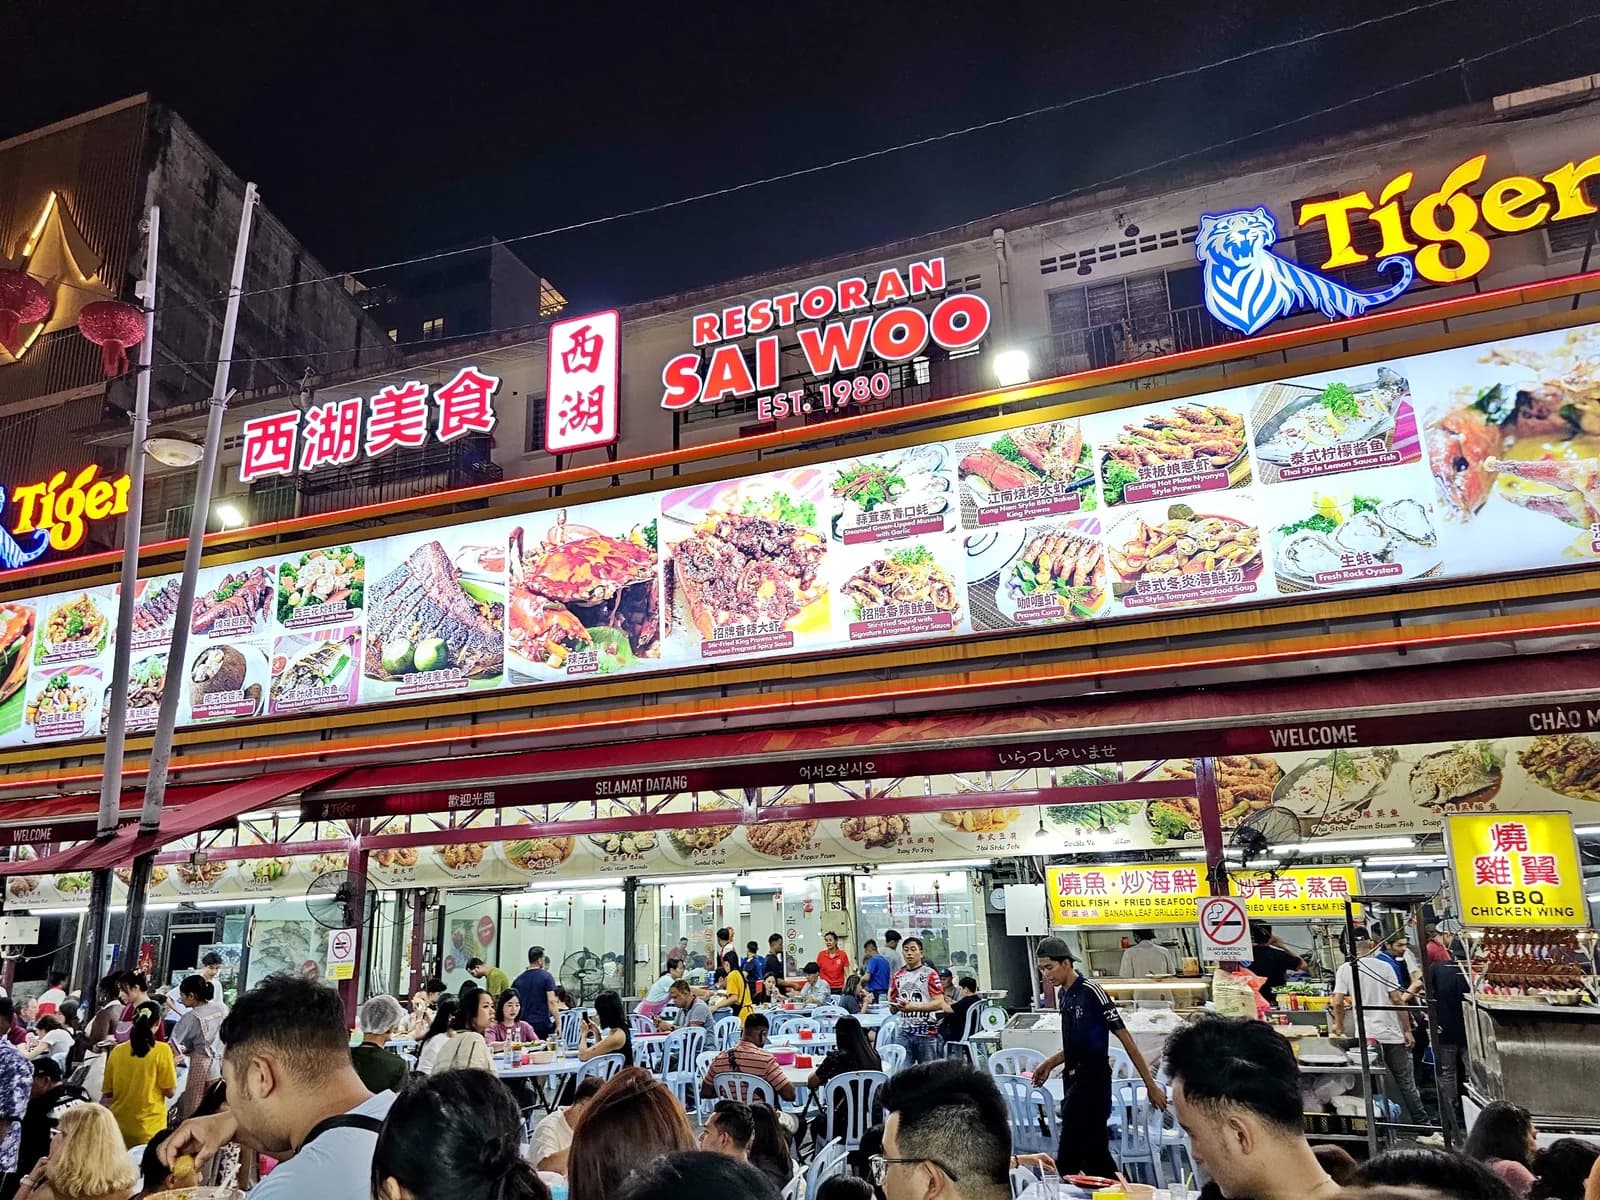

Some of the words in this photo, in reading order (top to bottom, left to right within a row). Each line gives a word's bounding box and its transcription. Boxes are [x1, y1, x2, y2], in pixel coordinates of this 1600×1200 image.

[1298, 154, 1600, 283] Tiger
[692, 257, 946, 346] RESTORAN
[661, 335, 780, 410] SAI
[798, 293, 991, 376] WOO
[559, 325, 605, 436] 西湖
[758, 391, 811, 420] EST.
[821, 372, 890, 407] 1980
[240, 367, 499, 482] 西湖美食
[1302, 466, 1322, 474] Style
[1324, 462, 1351, 470] Lemon
[1353, 458, 1378, 466] Sauce
[1380, 454, 1396, 462] Fish
[1128, 482, 1156, 491] Sizzling
[1173, 477, 1192, 485] Plate
[1194, 473, 1224, 482] Nyonya
[1152, 487, 1171, 495] Style
[1173, 484, 1201, 492] Prawns
[12, 464, 131, 550] Tiger
[1007, 510, 1023, 518] King
[1018, 501, 1035, 509] Style
[891, 528, 911, 536] Garlic
[1340, 551, 1373, 568] 生蚝
[1137, 568, 1242, 593] 泰式冬炎海鲜汤
[1319, 572, 1342, 580] Fresh
[1343, 570, 1364, 578] Rock
[1365, 567, 1399, 576] Oysters
[1128, 597, 1144, 605] Thai
[1145, 595, 1165, 604] Style
[1166, 591, 1198, 601] Tomyam
[1200, 586, 1233, 596] Seafood
[1234, 584, 1256, 592] Soup
[1529, 706, 1580, 731] CHÀO
[1269, 725, 1358, 747] WELCOME
[799, 761, 877, 780] 어서오십시오
[595, 779, 643, 796] SELAMAT
[646, 776, 688, 792] DATANG
[448, 791, 496, 808] 歡迎光臨
[13, 827, 52, 842] WELCOME
[1491, 823, 1527, 852] 燒
[1475, 856, 1559, 885] 雞翼
[831, 902, 841, 910] 53
[1124, 898, 1151, 906] FRIED
[1496, 890, 1544, 906] BBQ
[1104, 910, 1132, 918] BANANA
[1154, 908, 1184, 916] GRILLED
[1268, 904, 1290, 912] VEGE
[1471, 906, 1532, 916] CHICKEN
[1538, 907, 1574, 917] WING
